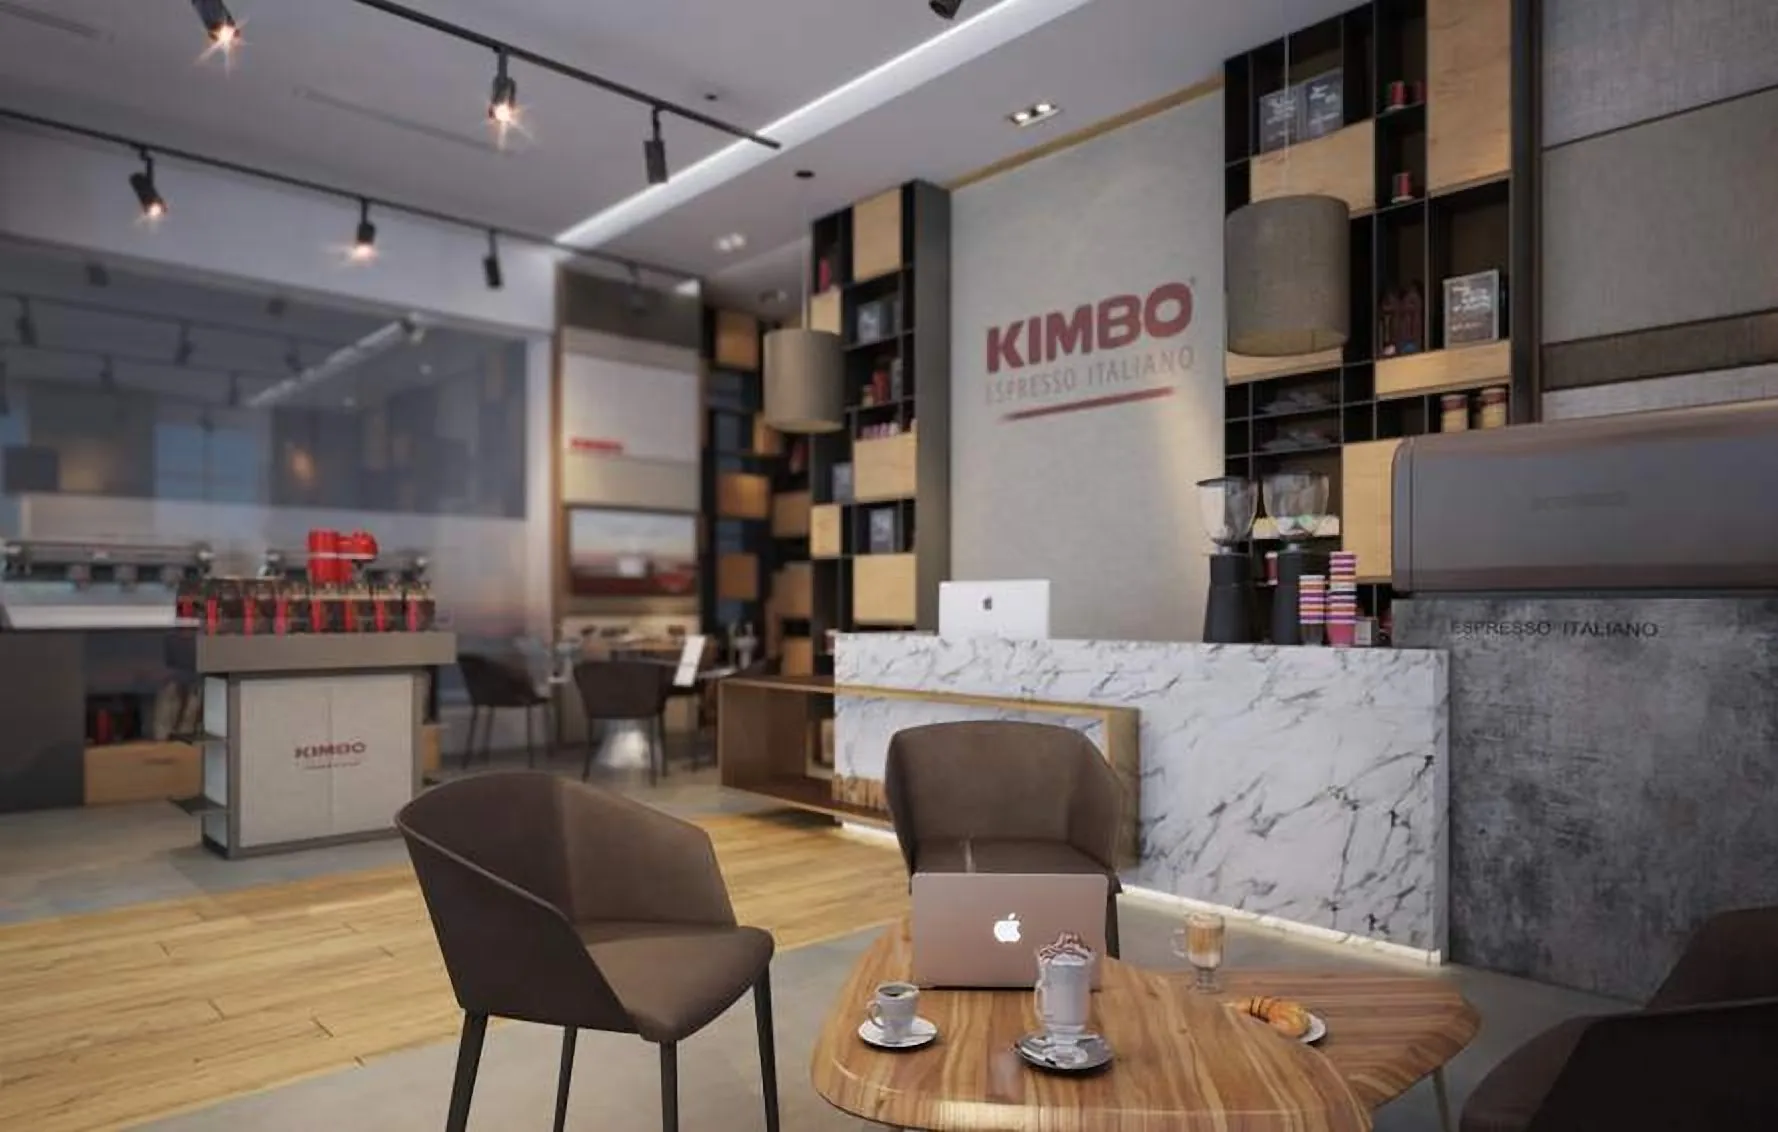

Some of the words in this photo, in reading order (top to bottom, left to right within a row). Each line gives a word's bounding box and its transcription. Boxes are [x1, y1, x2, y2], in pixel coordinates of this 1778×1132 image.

[986, 281, 1193, 374] KIMBO
[985, 368, 1076, 405] ESPRESSO
[1087, 345, 1195, 387] ITALIANO
[1451, 620, 1552, 637] ESPRESSO
[1562, 620, 1659, 638] ITALIANO
